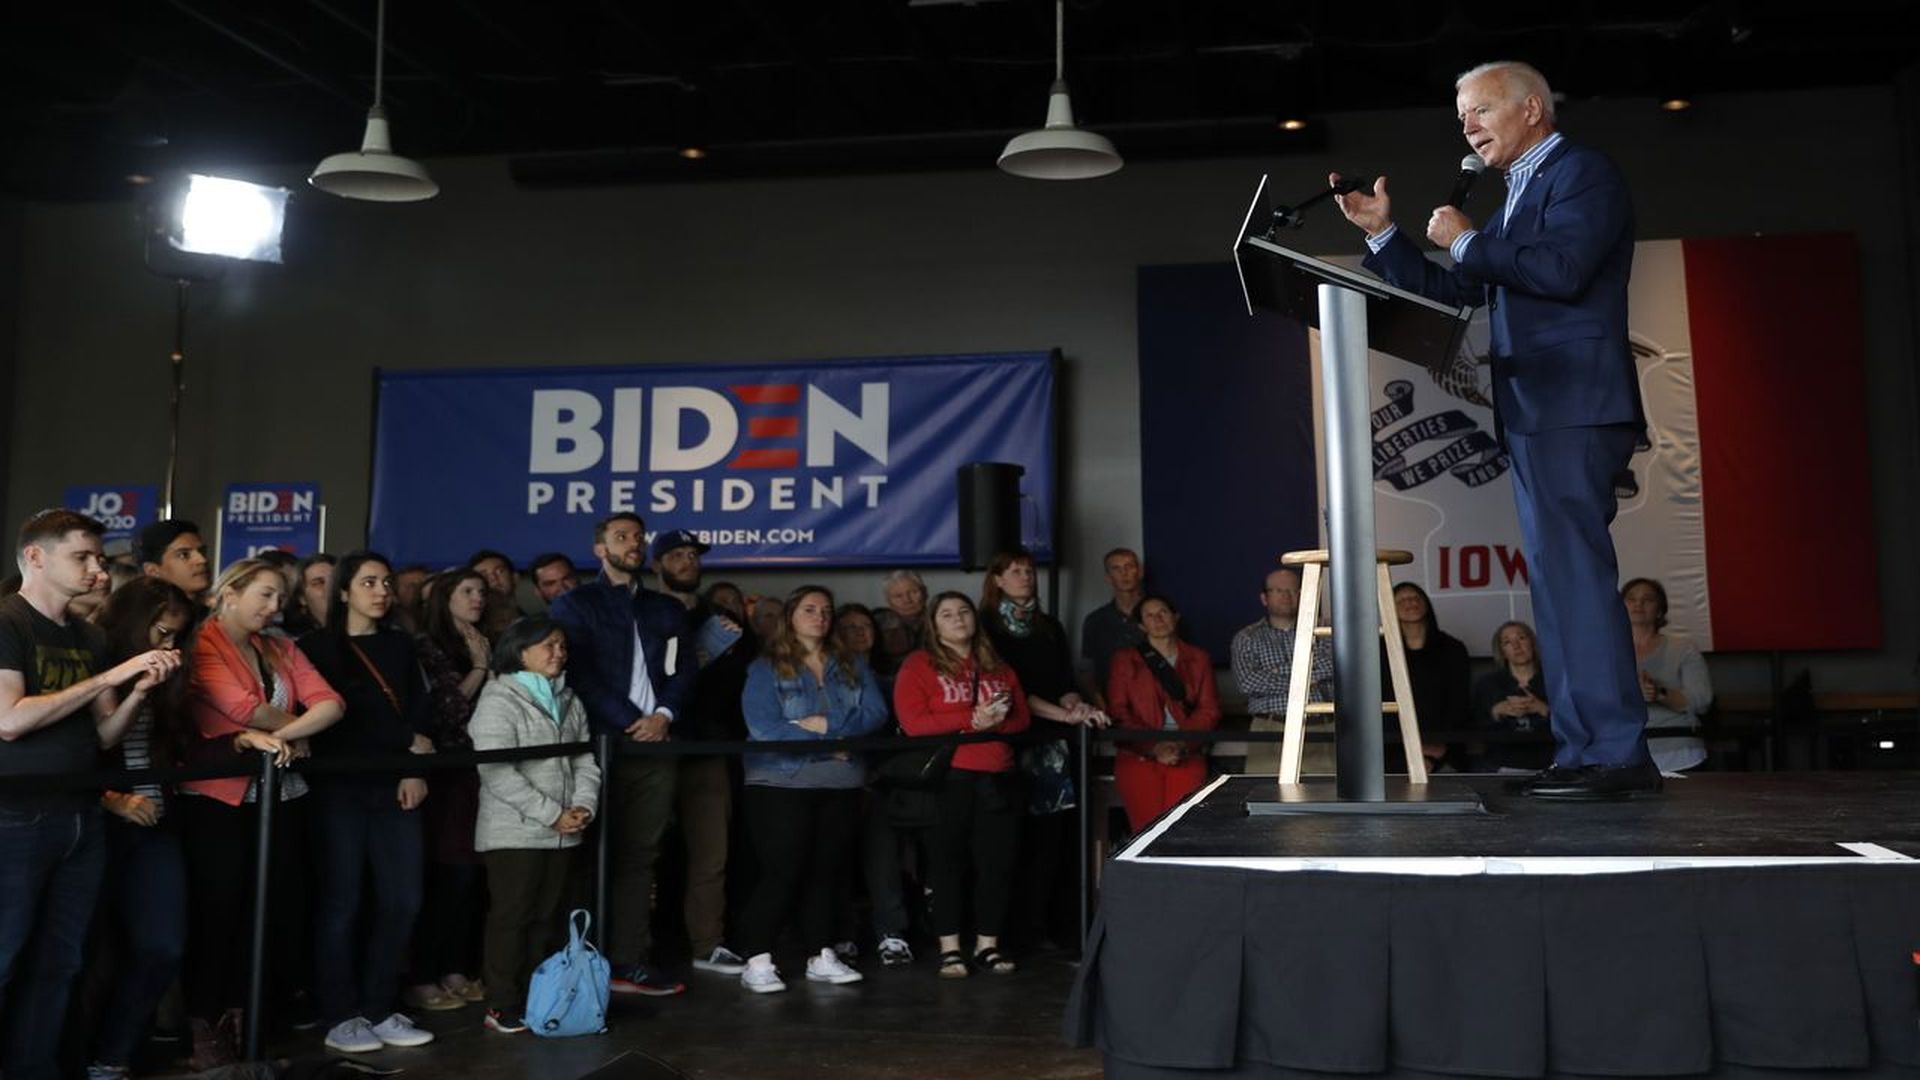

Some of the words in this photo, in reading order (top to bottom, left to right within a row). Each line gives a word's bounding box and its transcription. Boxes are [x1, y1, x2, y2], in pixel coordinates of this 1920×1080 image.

[529, 382, 889, 473] BIDEN
[1373, 416, 1447, 466] LIBERTIES
[1401, 465, 1426, 487] WE
[1428, 439, 1473, 474] PRIZE
[1468, 464, 1497, 486] AND
[228, 491, 314, 514] BIDEN
[528, 476, 888, 514] PRESIDENT
[228, 512, 313, 523] PRESIDENT
[1439, 544, 1529, 589] IOW
